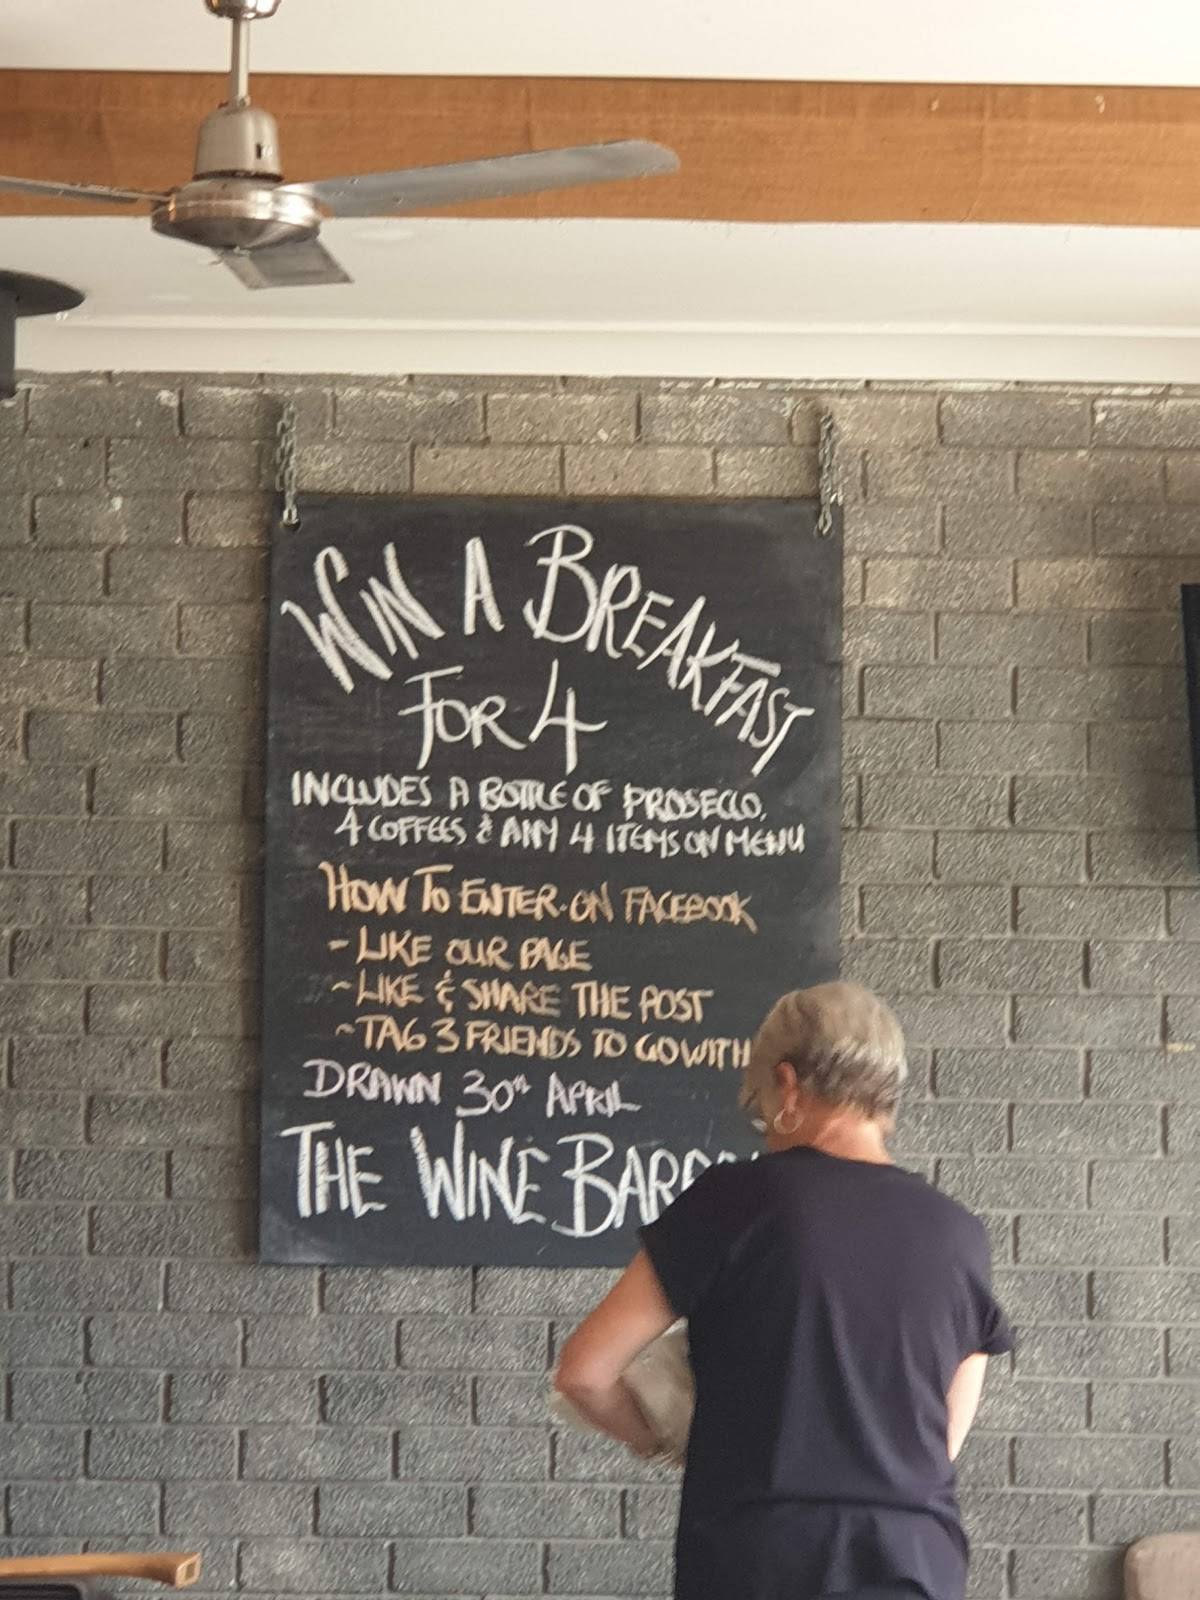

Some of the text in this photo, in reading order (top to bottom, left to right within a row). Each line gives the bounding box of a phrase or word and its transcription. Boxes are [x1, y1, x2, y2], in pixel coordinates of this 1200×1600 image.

[281, 524, 815, 777] WIN A BREAKFAST
[398, 658, 608, 775] FOR 4
[291, 770, 432, 807] INCLUDES
[450, 776, 470, 811] A
[479, 776, 568, 812] BOTTLE
[572, 779, 613, 812] OF
[334, 806, 806, 859] 4 COFFEES & ANY 4 ITEMS ON MENU
[318, 861, 410, 916] HOW
[413, 864, 454, 914] TO
[621, 885, 758, 935] FACEBOOK
[355, 925, 432, 967] LIKE
[446, 935, 514, 971] OUR
[520, 936, 593, 972] PAGE
[355, 968, 425, 1008] LIKE
[434, 969, 455, 1014] &
[461, 977, 562, 1017] SHARE
[570, 979, 633, 1020] THE
[638, 984, 715, 1024] POST
[354, 1014, 427, 1052] TAG
[431, 1017, 461, 1054] 3
[465, 1019, 582, 1060] FRIENDS
[591, 1027, 628, 1059] TO
[302, 1058, 442, 1106] DRAWN
[546, 1071, 642, 1118] APRIL
[278, 1119, 759, 1238] THE WINE BAR
